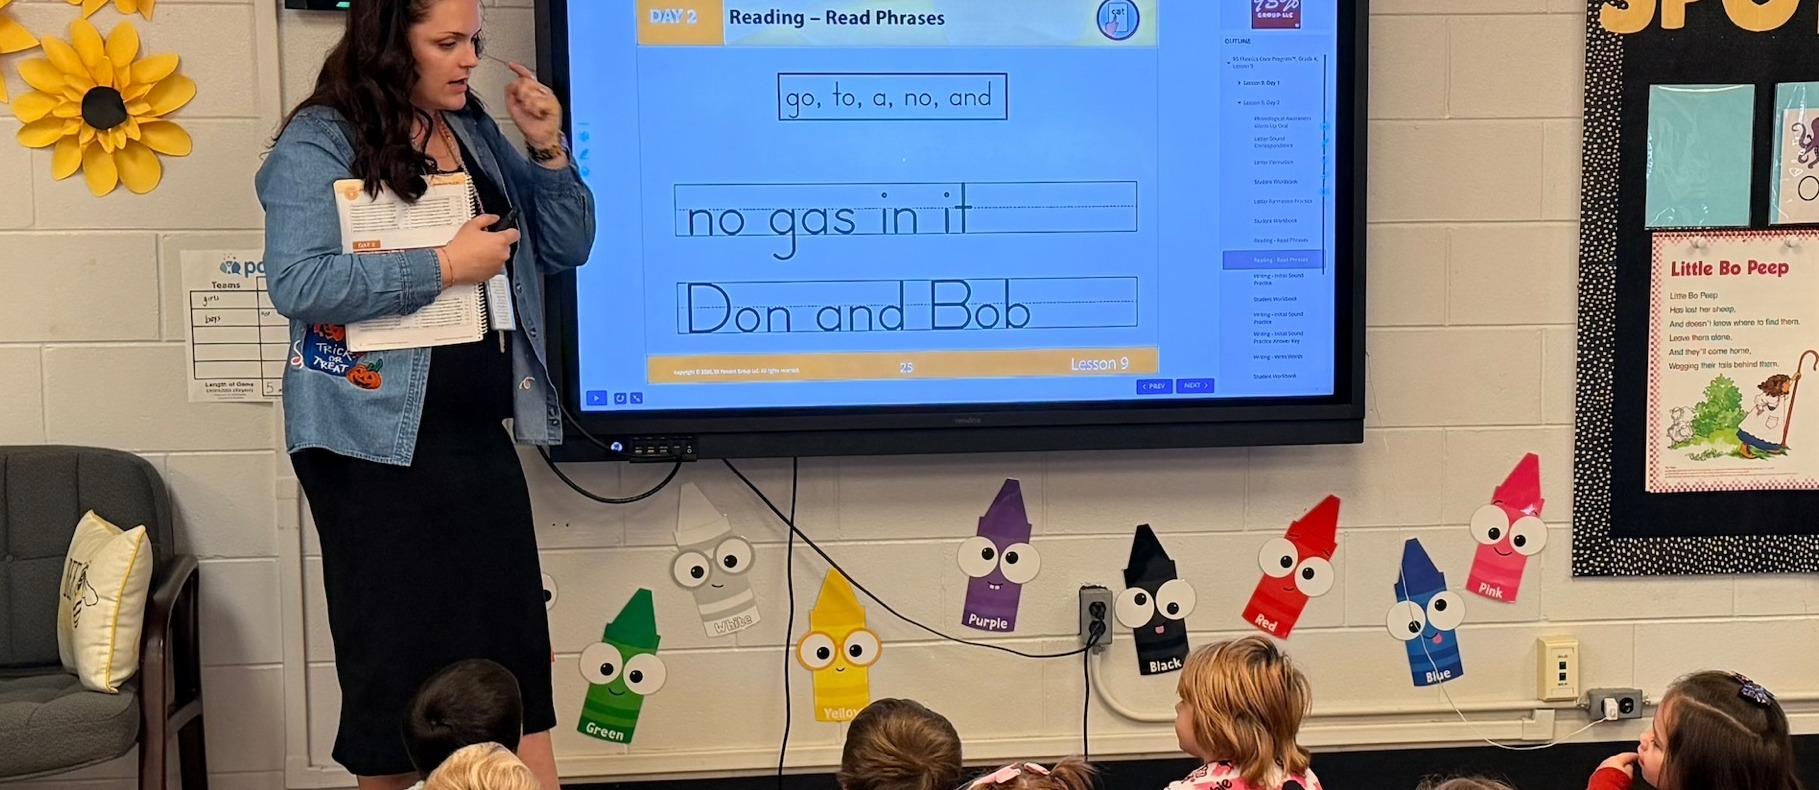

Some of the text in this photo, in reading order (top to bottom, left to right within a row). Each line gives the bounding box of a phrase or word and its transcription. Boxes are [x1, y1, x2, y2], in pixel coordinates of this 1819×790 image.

[650, 8, 698, 24] DAY 2
[729, 9, 805, 28] Reading
[826, 10, 871, 26] Read
[876, 10, 946, 26] Phrases
[786, 80, 991, 118] go, to, a, no, and
[689, 182, 973, 261] no gas in it
[1670, 260, 1790, 278] Little Bo Peep
[1700, 292, 1718, 300] Peep
[687, 278, 1031, 334] Don and Bob
[314, 355, 349, 373] TREAT
[900, 362, 914, 374] 25
[1071, 356, 1129, 372] Lesson 9
[1669, 363, 1699, 371] Wagging
[266, 382, 274, 393] 5
[1478, 582, 1503, 598] Pink
[713, 614, 752, 634] White
[968, 613, 1008, 630] Purple
[1255, 613, 1278, 632] Red
[1149, 658, 1182, 673] Black
[1425, 669, 1451, 683] Blue
[586, 722, 624, 741] Green
